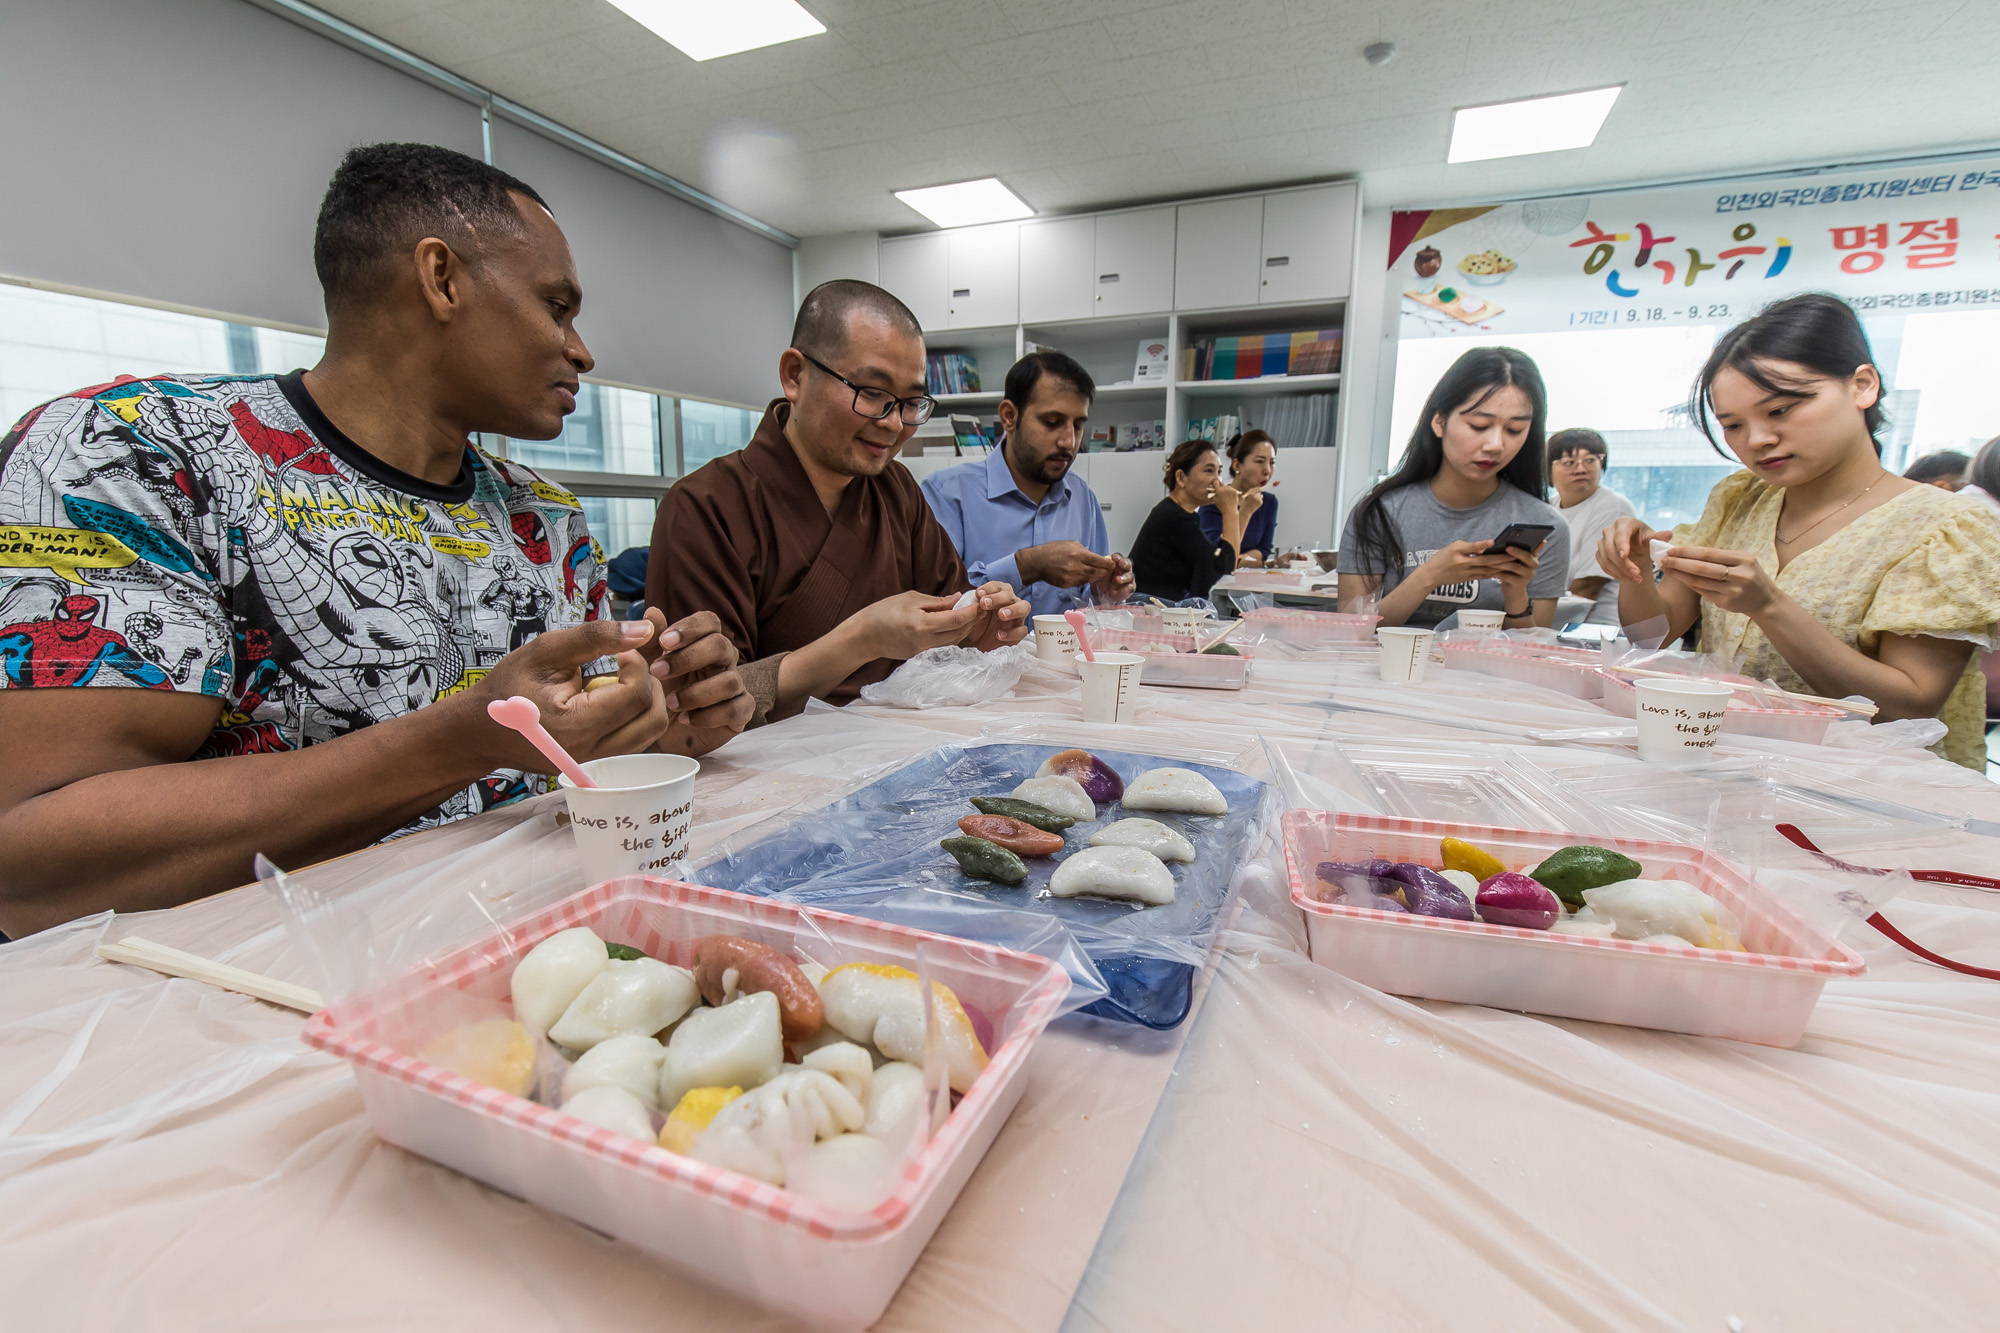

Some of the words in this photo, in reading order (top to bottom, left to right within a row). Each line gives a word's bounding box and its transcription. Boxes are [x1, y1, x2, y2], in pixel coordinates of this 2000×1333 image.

[1715, 174, 1955, 213] 인천외국인종합지원센터
[1568, 221, 1793, 297] 한가위
[1828, 217, 1960, 275] 명절
[29, 532, 80, 543] THAT
[1641, 702, 1671, 716] Love
[1674, 708, 1692, 721] is,
[1674, 723, 1700, 734] the
[571, 810, 609, 830] Love
[614, 815, 640, 831] is,
[647, 800, 691, 826] above
[619, 837, 655, 852] the
[661, 821, 690, 849] gift
